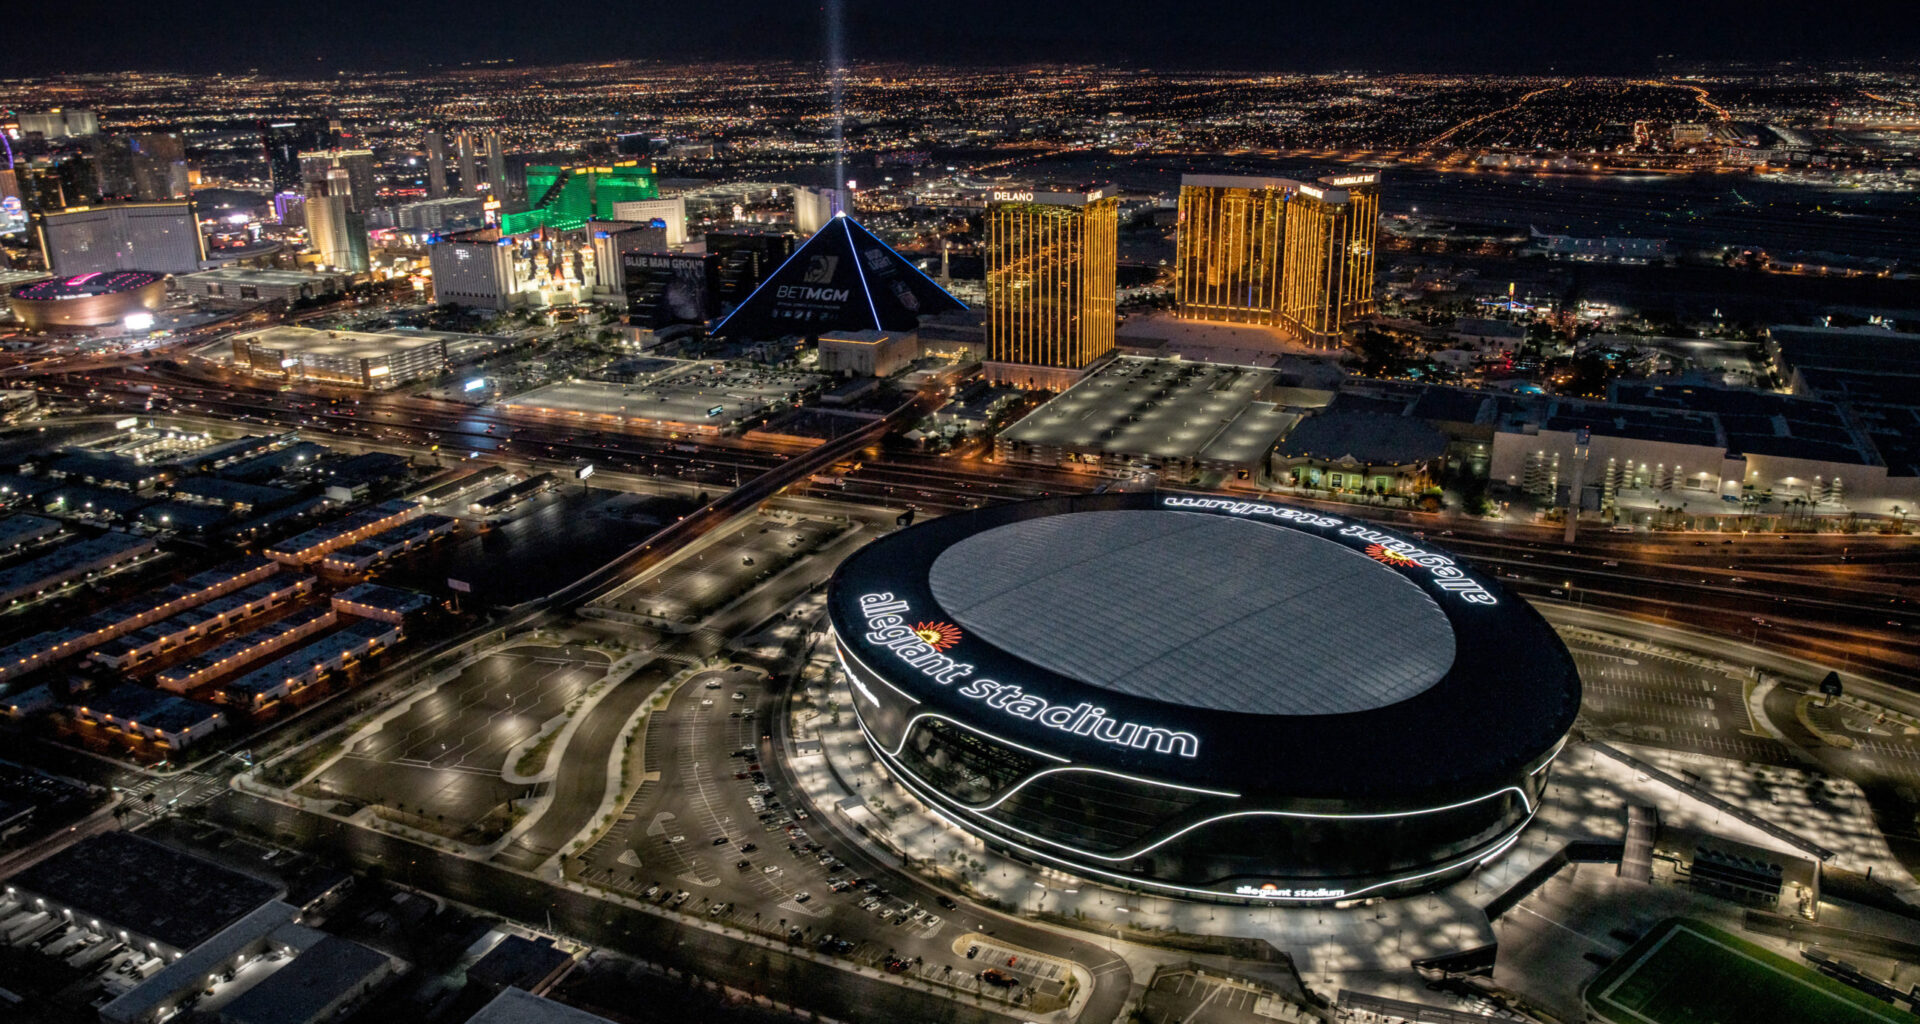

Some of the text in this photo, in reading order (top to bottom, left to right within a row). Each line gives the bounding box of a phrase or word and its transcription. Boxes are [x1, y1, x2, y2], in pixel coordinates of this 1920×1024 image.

[993, 191, 1034, 202] DELANO
[624, 256, 705, 270] BLUE MAN GROUP
[776, 285, 850, 302] BETMGM
[1164, 497, 1498, 605] allegiant stadium
[859, 591, 975, 685] allegiant
[958, 678, 1199, 758] stadium
[1235, 885, 1346, 898] allegiant stadium
